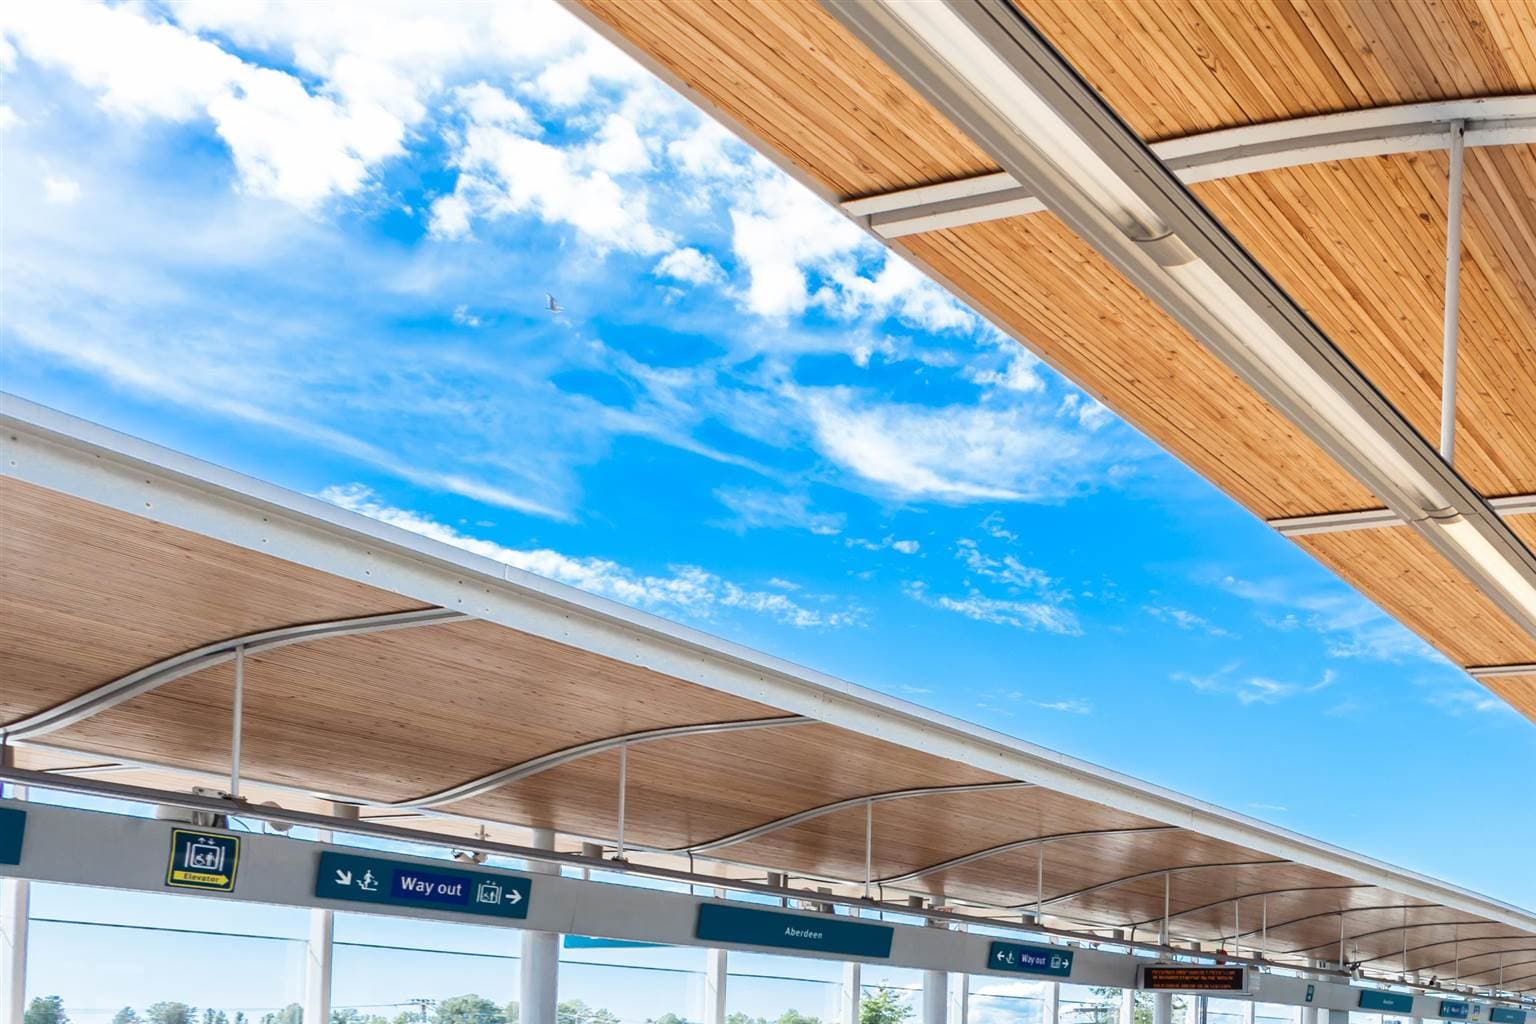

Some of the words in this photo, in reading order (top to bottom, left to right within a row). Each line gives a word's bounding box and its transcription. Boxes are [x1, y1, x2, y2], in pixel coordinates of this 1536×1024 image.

[184, 872, 219, 883] Elevator
[401, 876, 435, 896] Way
[438, 884, 463, 896] out
[785, 927, 823, 940] Aberdeen
[1021, 952, 1036, 965] Way
[1035, 956, 1046, 966] out
